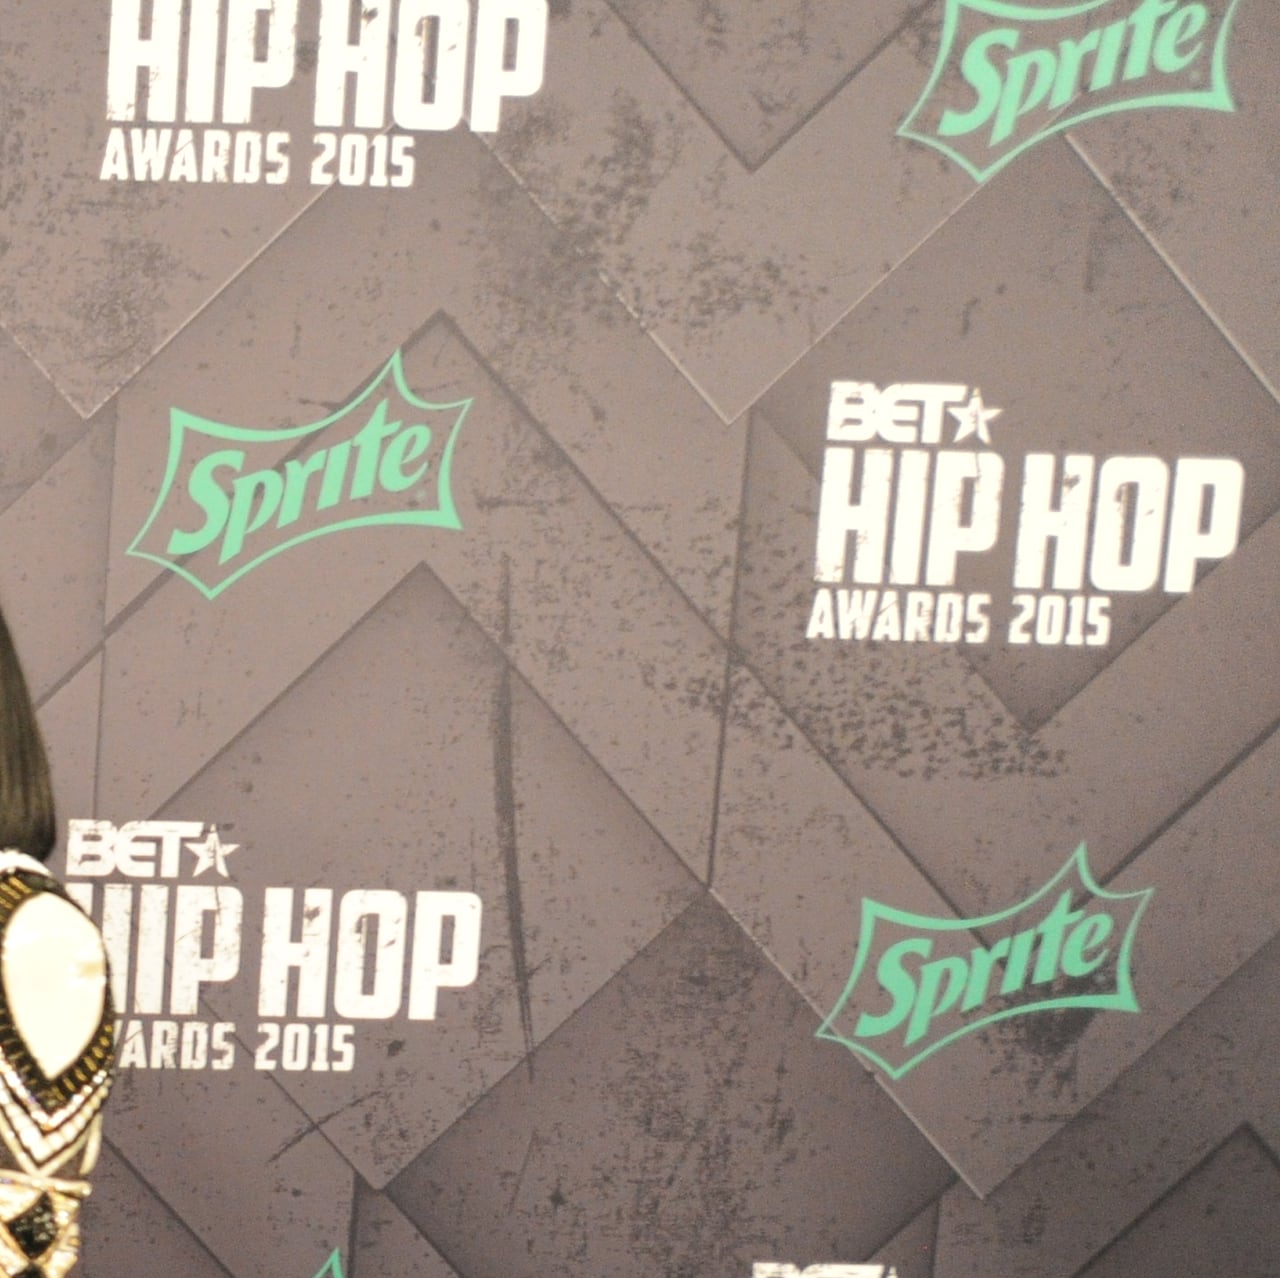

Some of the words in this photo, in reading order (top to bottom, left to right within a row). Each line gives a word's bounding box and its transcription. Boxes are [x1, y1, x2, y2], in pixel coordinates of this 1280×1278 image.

[105, 0, 300, 125] HIP
[312, 0, 549, 134] HOP
[937, 0, 1209, 146] Sprite
[98, 126, 291, 185] AWARDS
[309, 131, 416, 188] 2015
[826, 380, 969, 445] BET
[167, 399, 433, 563] Sprite
[813, 446, 1005, 587] HIP
[1013, 452, 1245, 594] HOP
[805, 587, 991, 644] AWARDS
[1007, 593, 1111, 646] 2015
[65, 818, 205, 879] BET
[257, 886, 483, 1021] HOP
[854, 890, 1114, 1047] Sprite
[113, 1019, 236, 1071] ARDS
[254, 1022, 355, 1072] 2015
